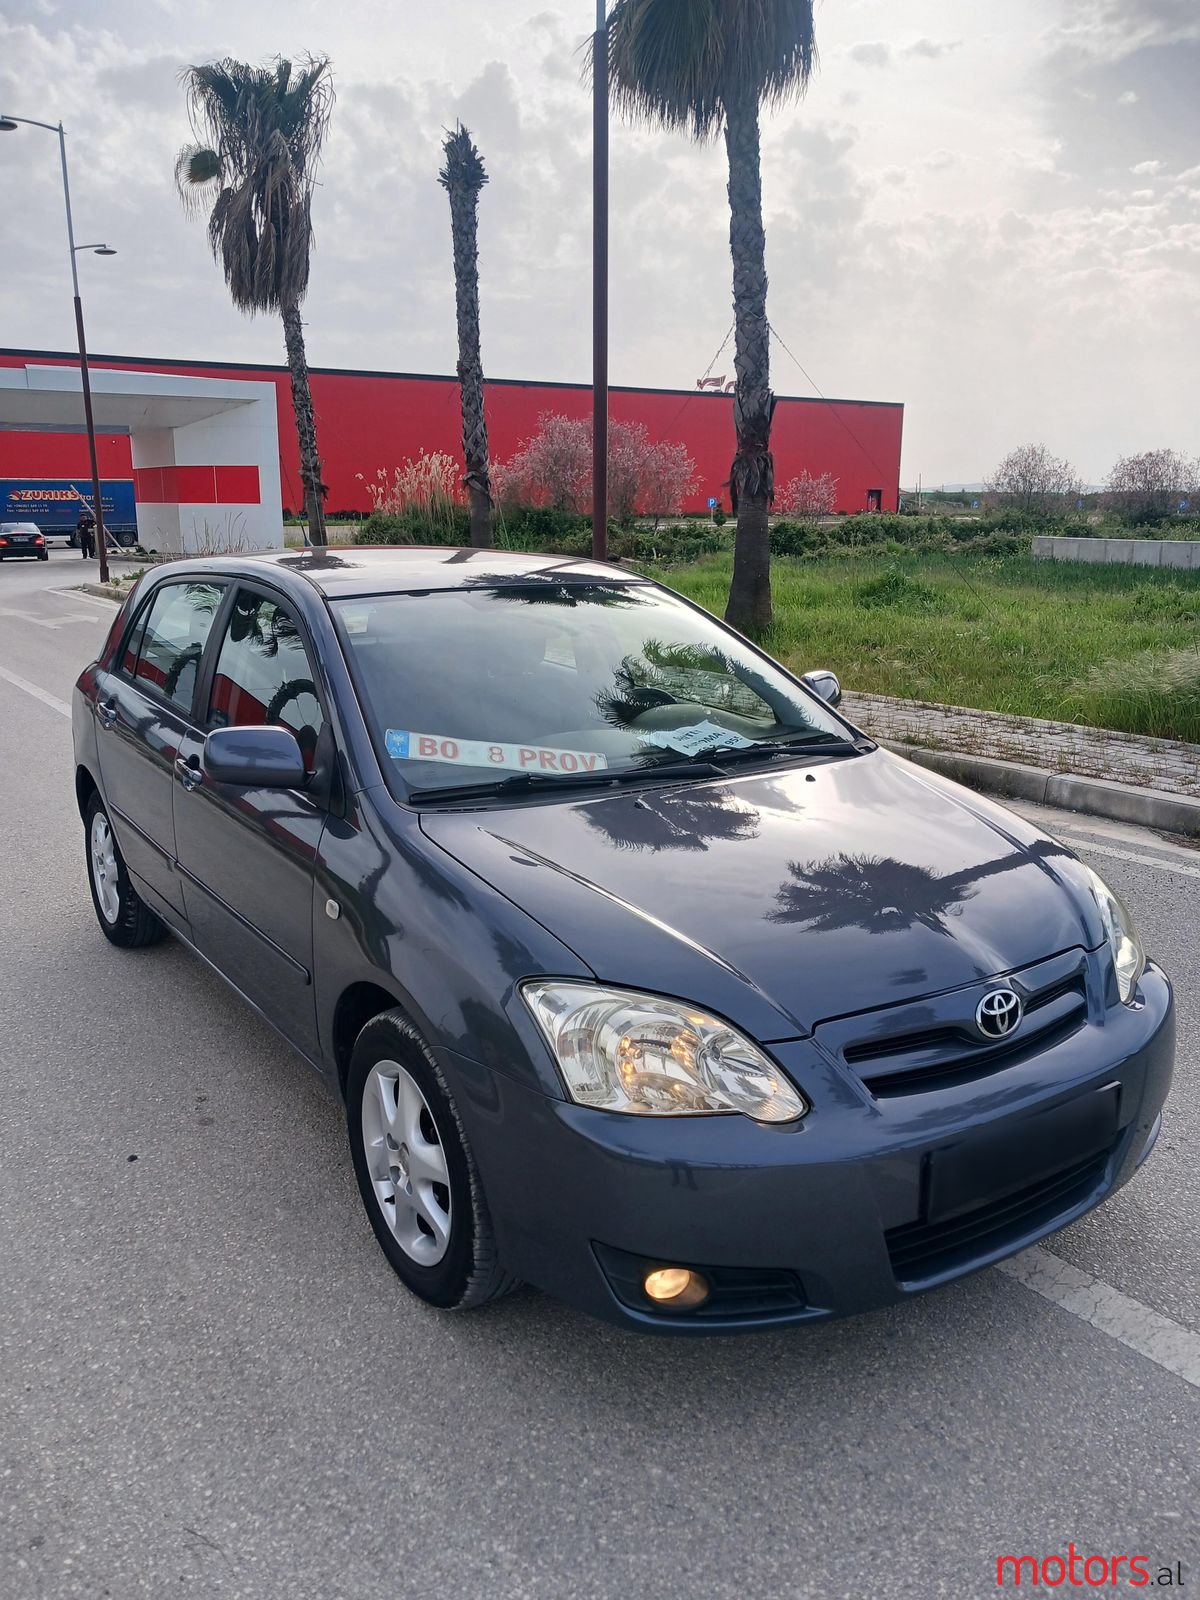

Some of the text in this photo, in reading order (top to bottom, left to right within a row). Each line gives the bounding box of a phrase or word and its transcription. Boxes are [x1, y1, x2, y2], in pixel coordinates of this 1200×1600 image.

[20, 489, 80, 501] ZUMIKS
[709, 498, 715, 508] P
[489, 746, 505, 763] 8
[519, 748, 597, 772] PROV
